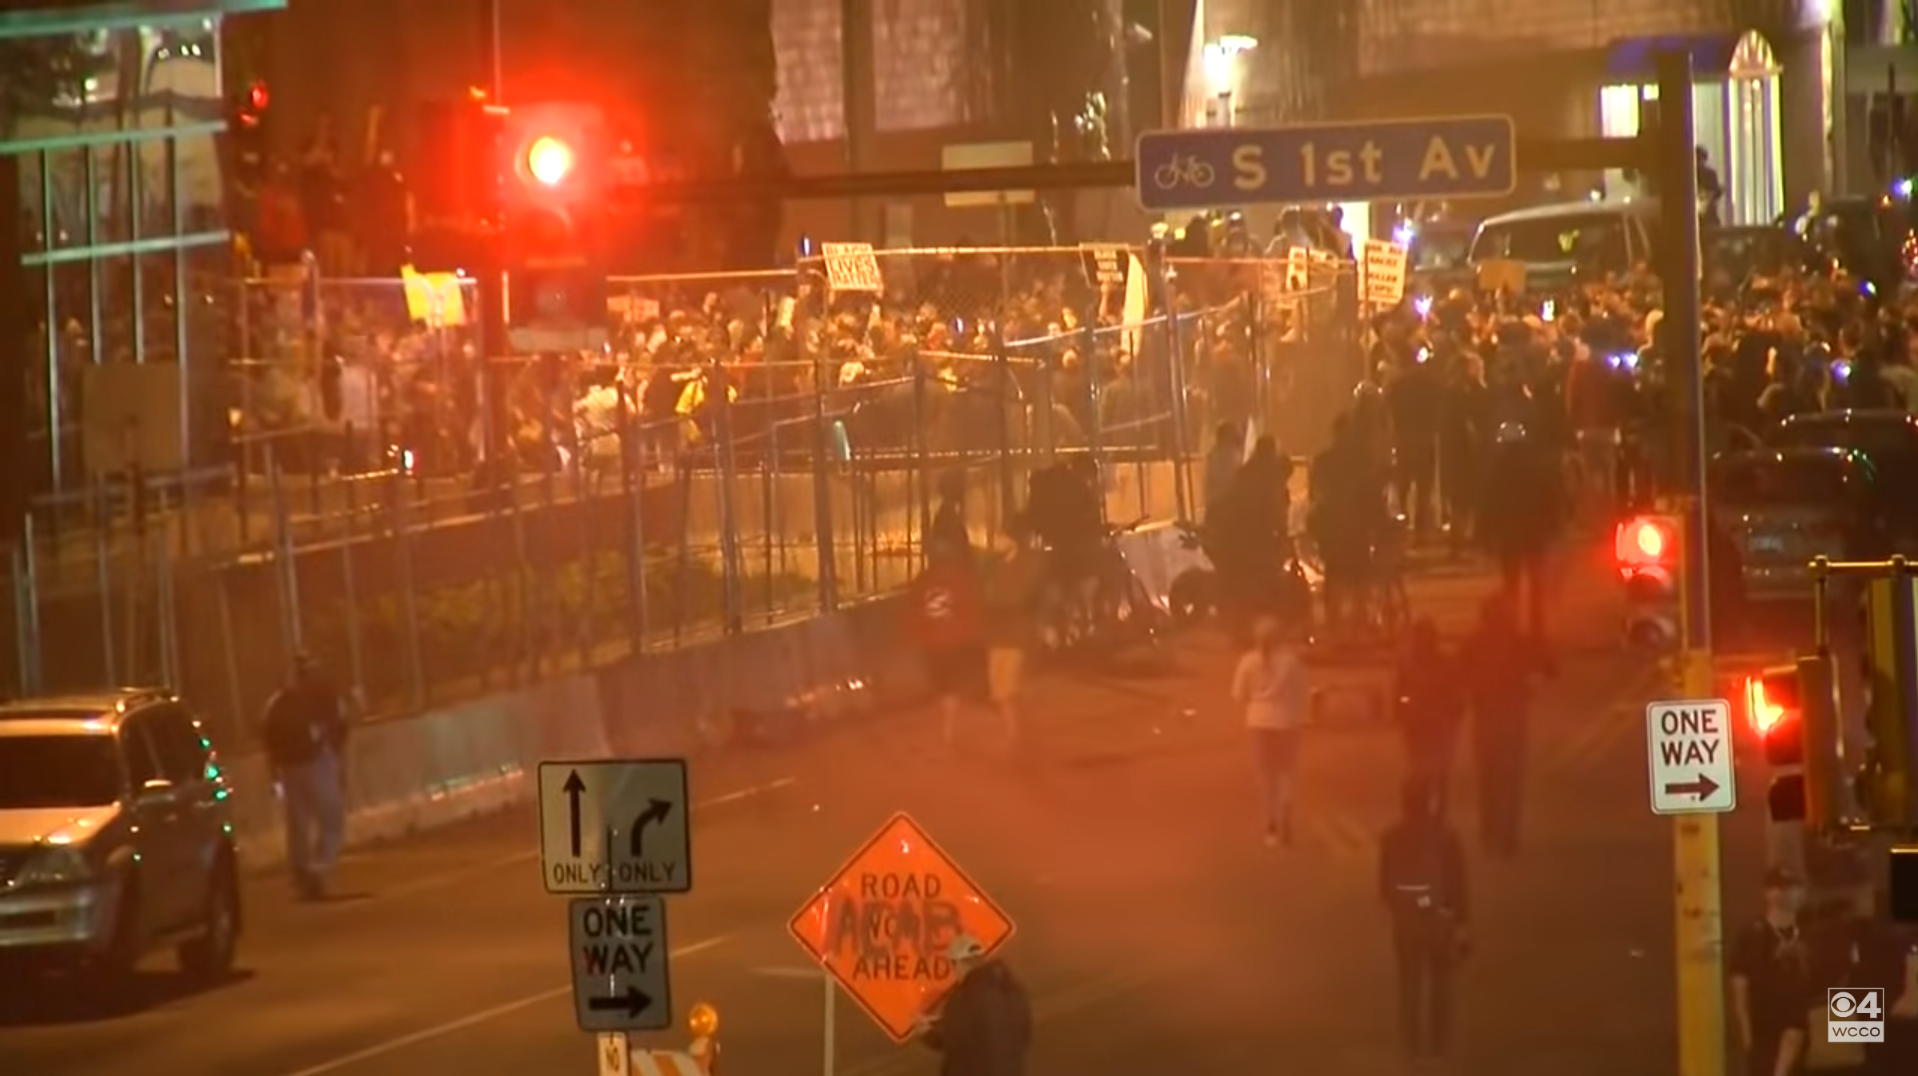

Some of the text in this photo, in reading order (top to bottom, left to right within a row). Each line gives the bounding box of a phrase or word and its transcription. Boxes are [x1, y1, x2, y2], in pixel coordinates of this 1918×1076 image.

[1232, 135, 1496, 190] S 1st Av
[828, 254, 874, 272] LIVES
[1661, 709, 1718, 735] ONE
[1660, 738, 1719, 766] WAY
[553, 862, 600, 884] ONLY
[619, 861, 676, 883] ONLY
[861, 872, 942, 899] ROAD
[583, 905, 653, 938] ONE
[582, 941, 654, 976] WAY
[852, 953, 950, 981] AHEAD
